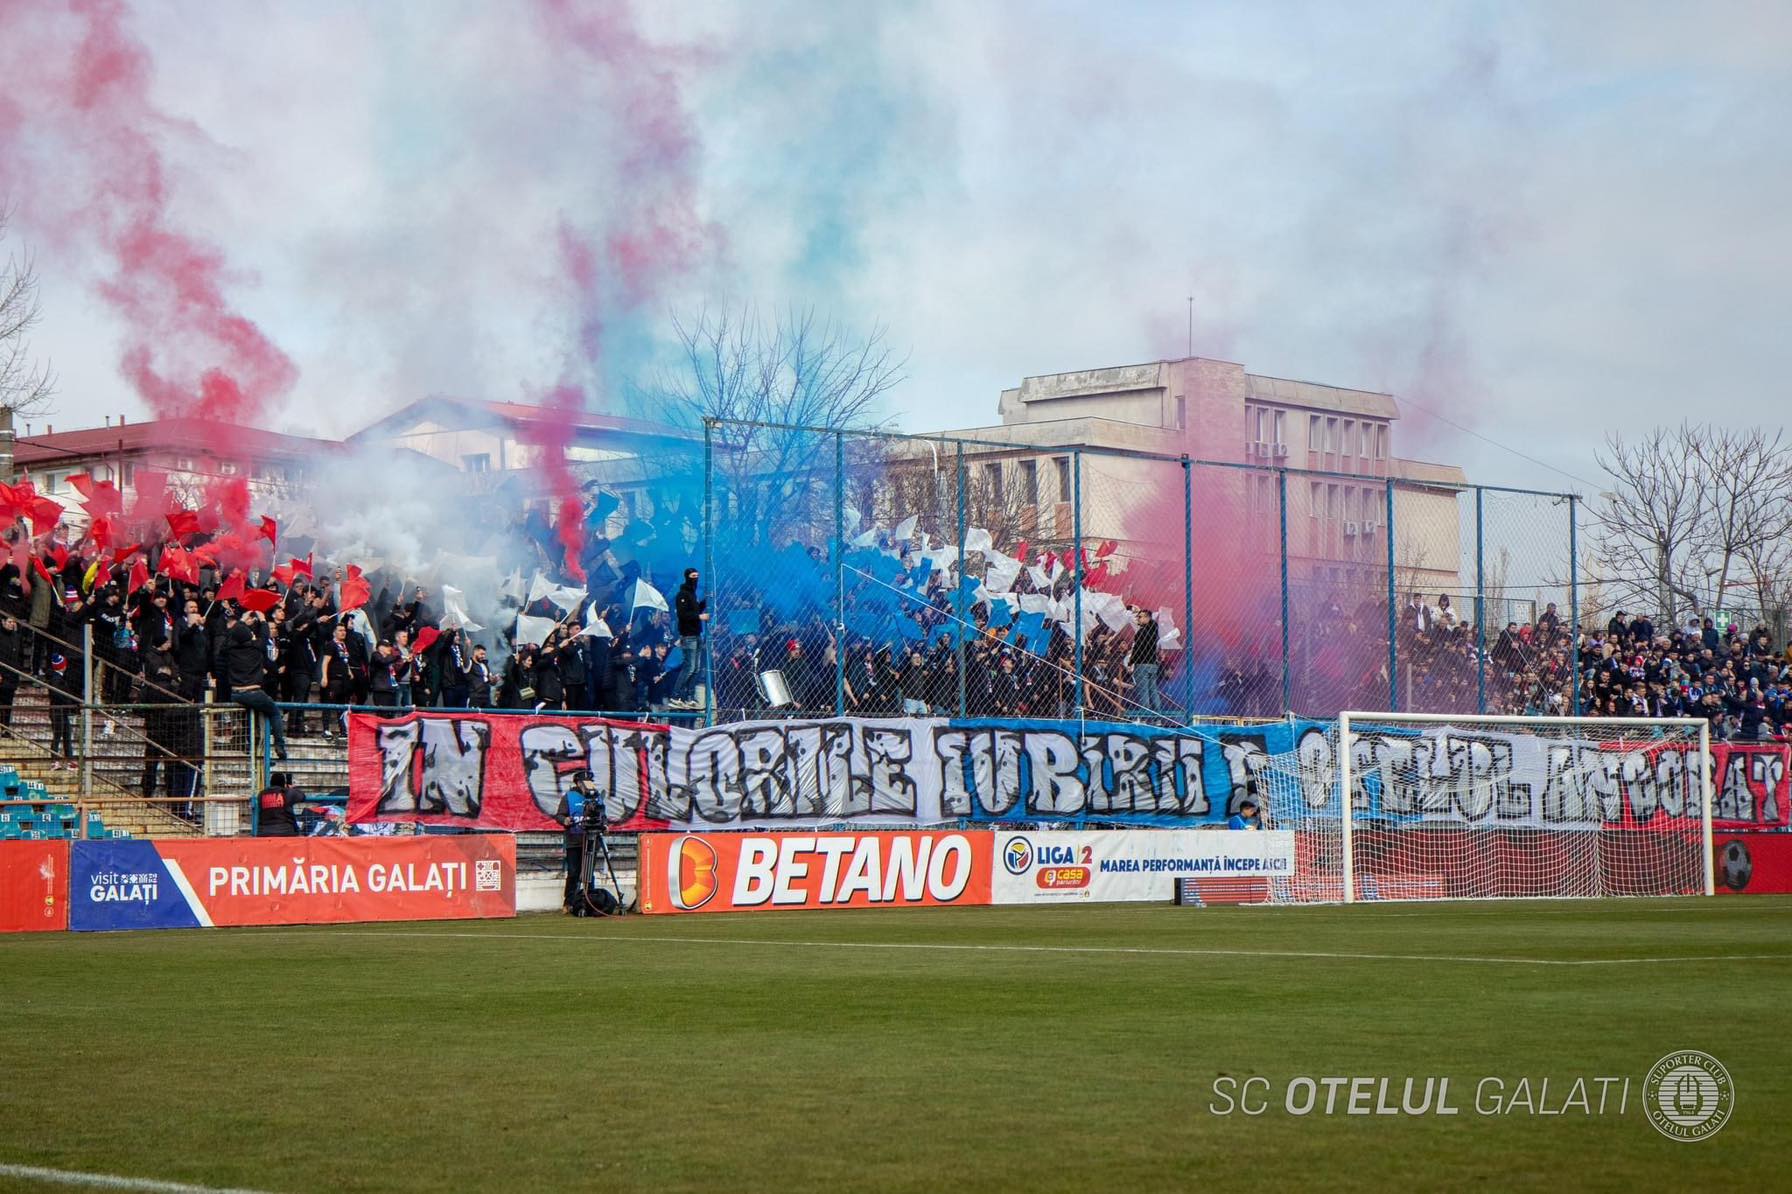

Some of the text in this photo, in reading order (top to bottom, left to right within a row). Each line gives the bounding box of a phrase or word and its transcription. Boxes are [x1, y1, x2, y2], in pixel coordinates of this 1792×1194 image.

[1037, 845, 1092, 864] LIGA 2
[1100, 859, 1140, 873] MAREA
[1142, 856, 1221, 874] PERFORMANȚĂ
[1223, 855, 1260, 871] ÎNCEPE
[90, 871, 119, 885] visit
[209, 857, 467, 898] PRIMĂRIA GALAȚI
[732, 835, 973, 906] BETANO
[90, 884, 158, 905] GALAȚI
